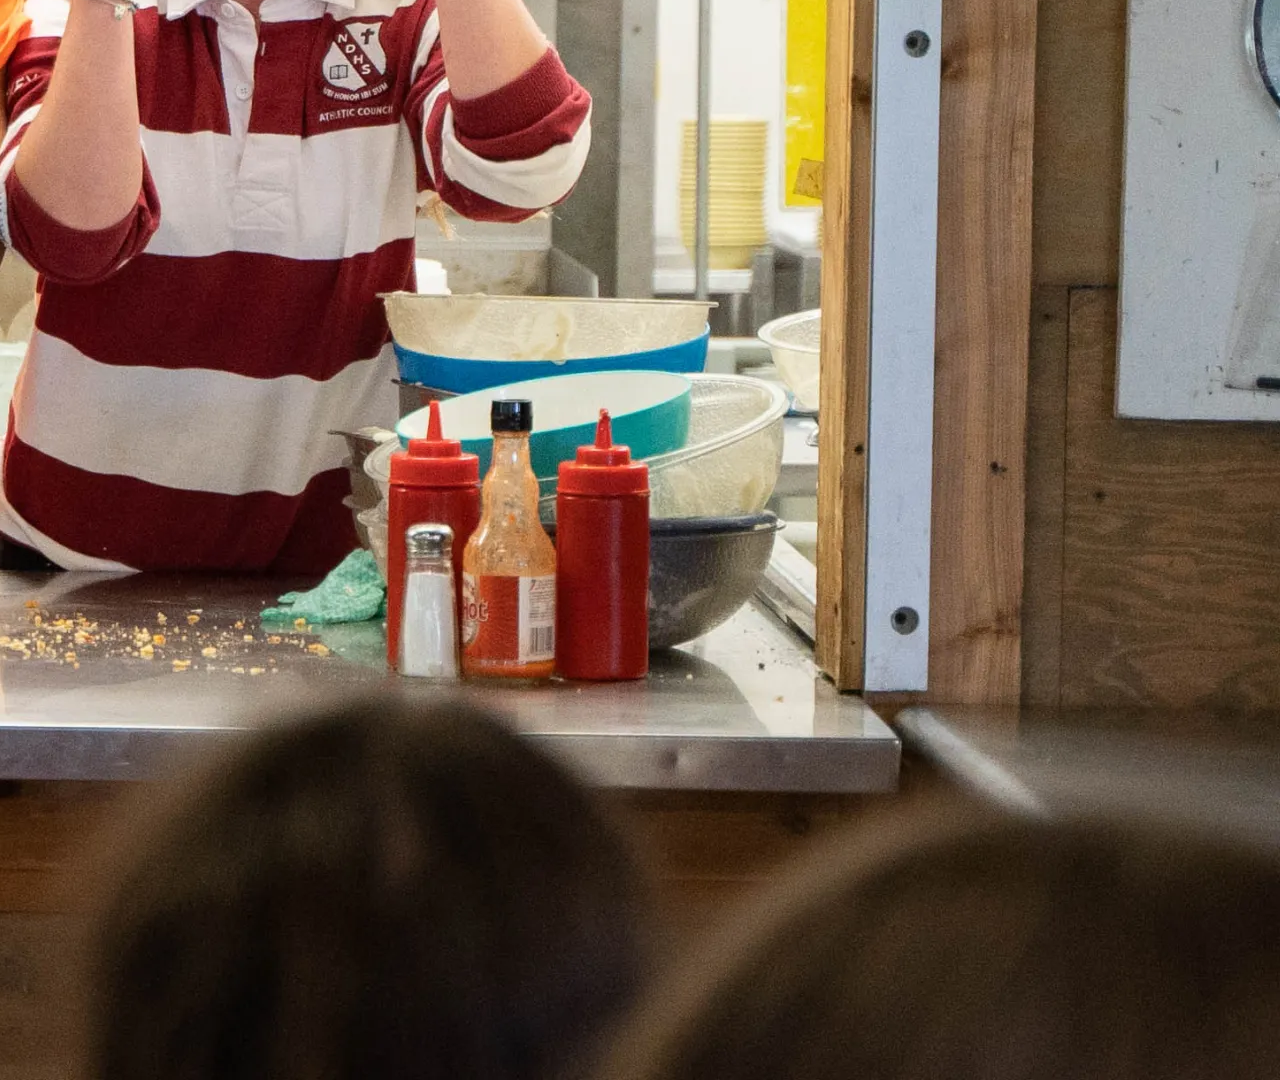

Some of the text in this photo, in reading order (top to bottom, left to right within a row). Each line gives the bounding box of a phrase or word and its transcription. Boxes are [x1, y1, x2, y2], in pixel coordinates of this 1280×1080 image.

[337, 33, 372, 75] NDHS
[334, 92, 360, 101] HONOR
[372, 82, 389, 95] SUM
